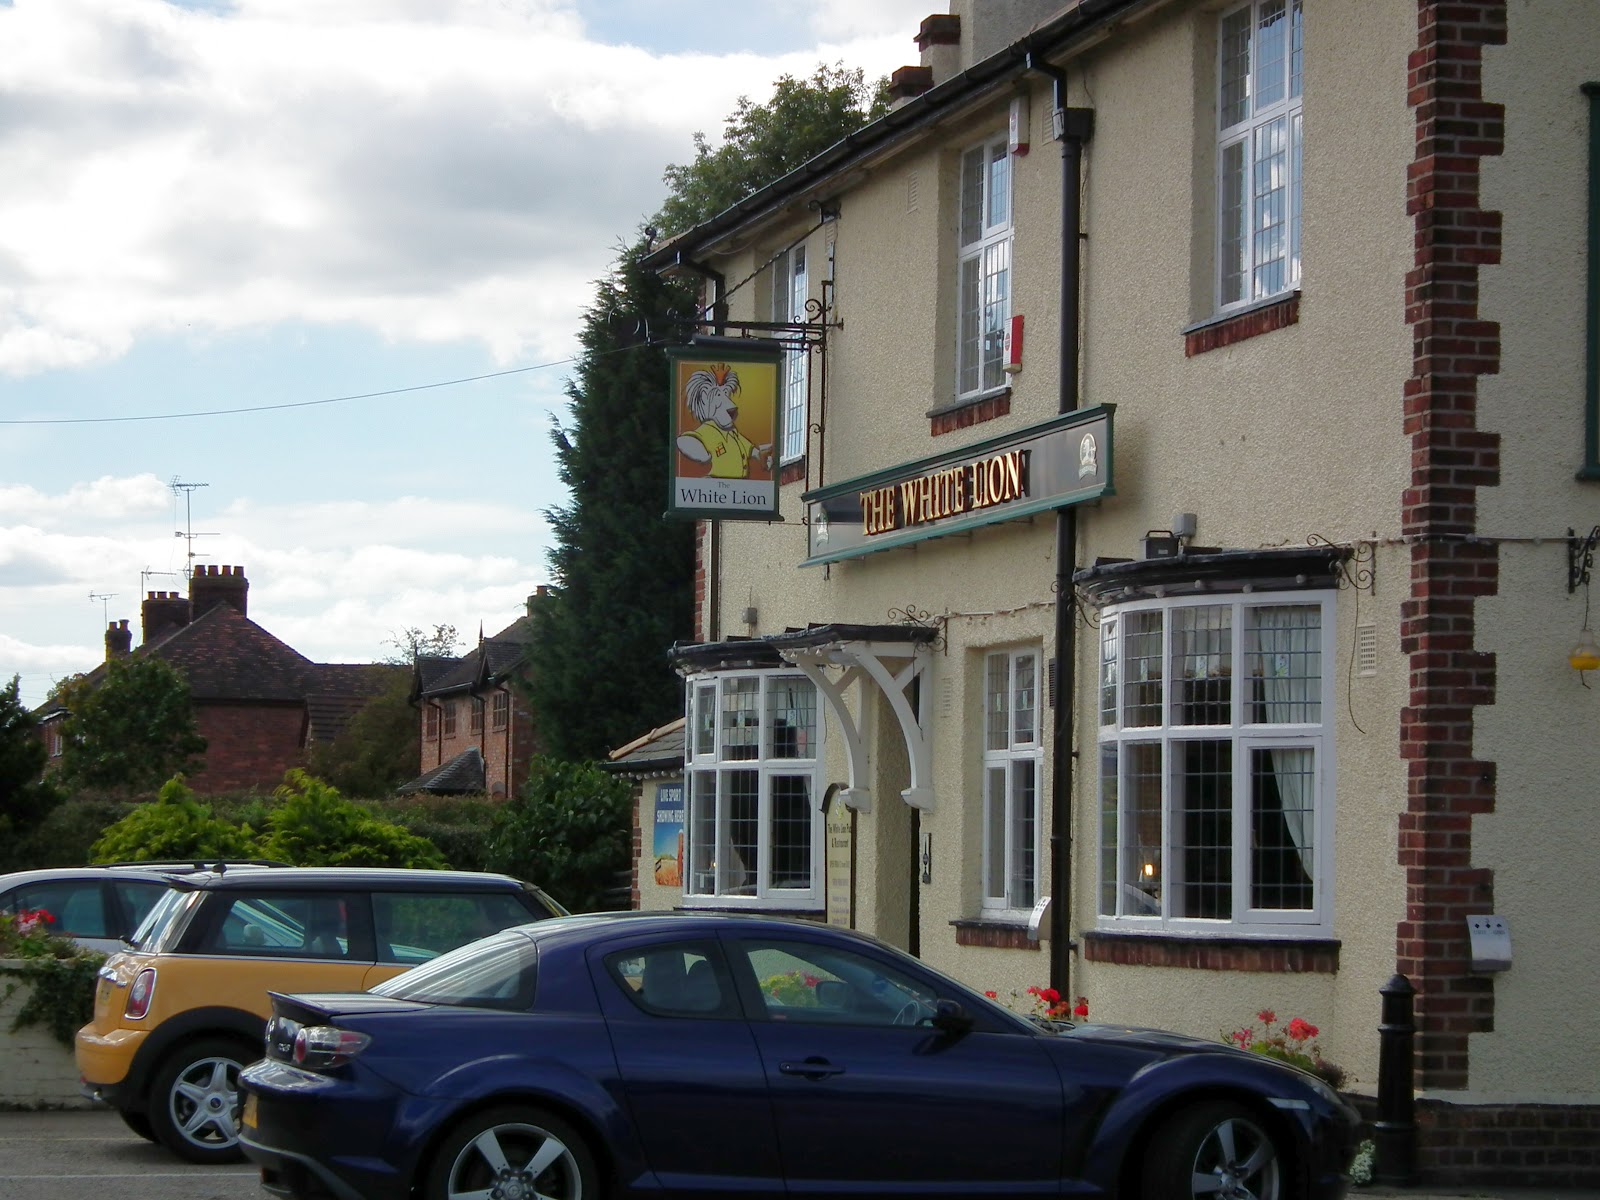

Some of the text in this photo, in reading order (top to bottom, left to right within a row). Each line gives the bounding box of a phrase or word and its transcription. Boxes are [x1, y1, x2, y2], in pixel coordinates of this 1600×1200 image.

[717, 481, 730, 489] The
[860, 450, 1022, 536] THE WHITE LION
[680, 488, 767, 505] White Lion
